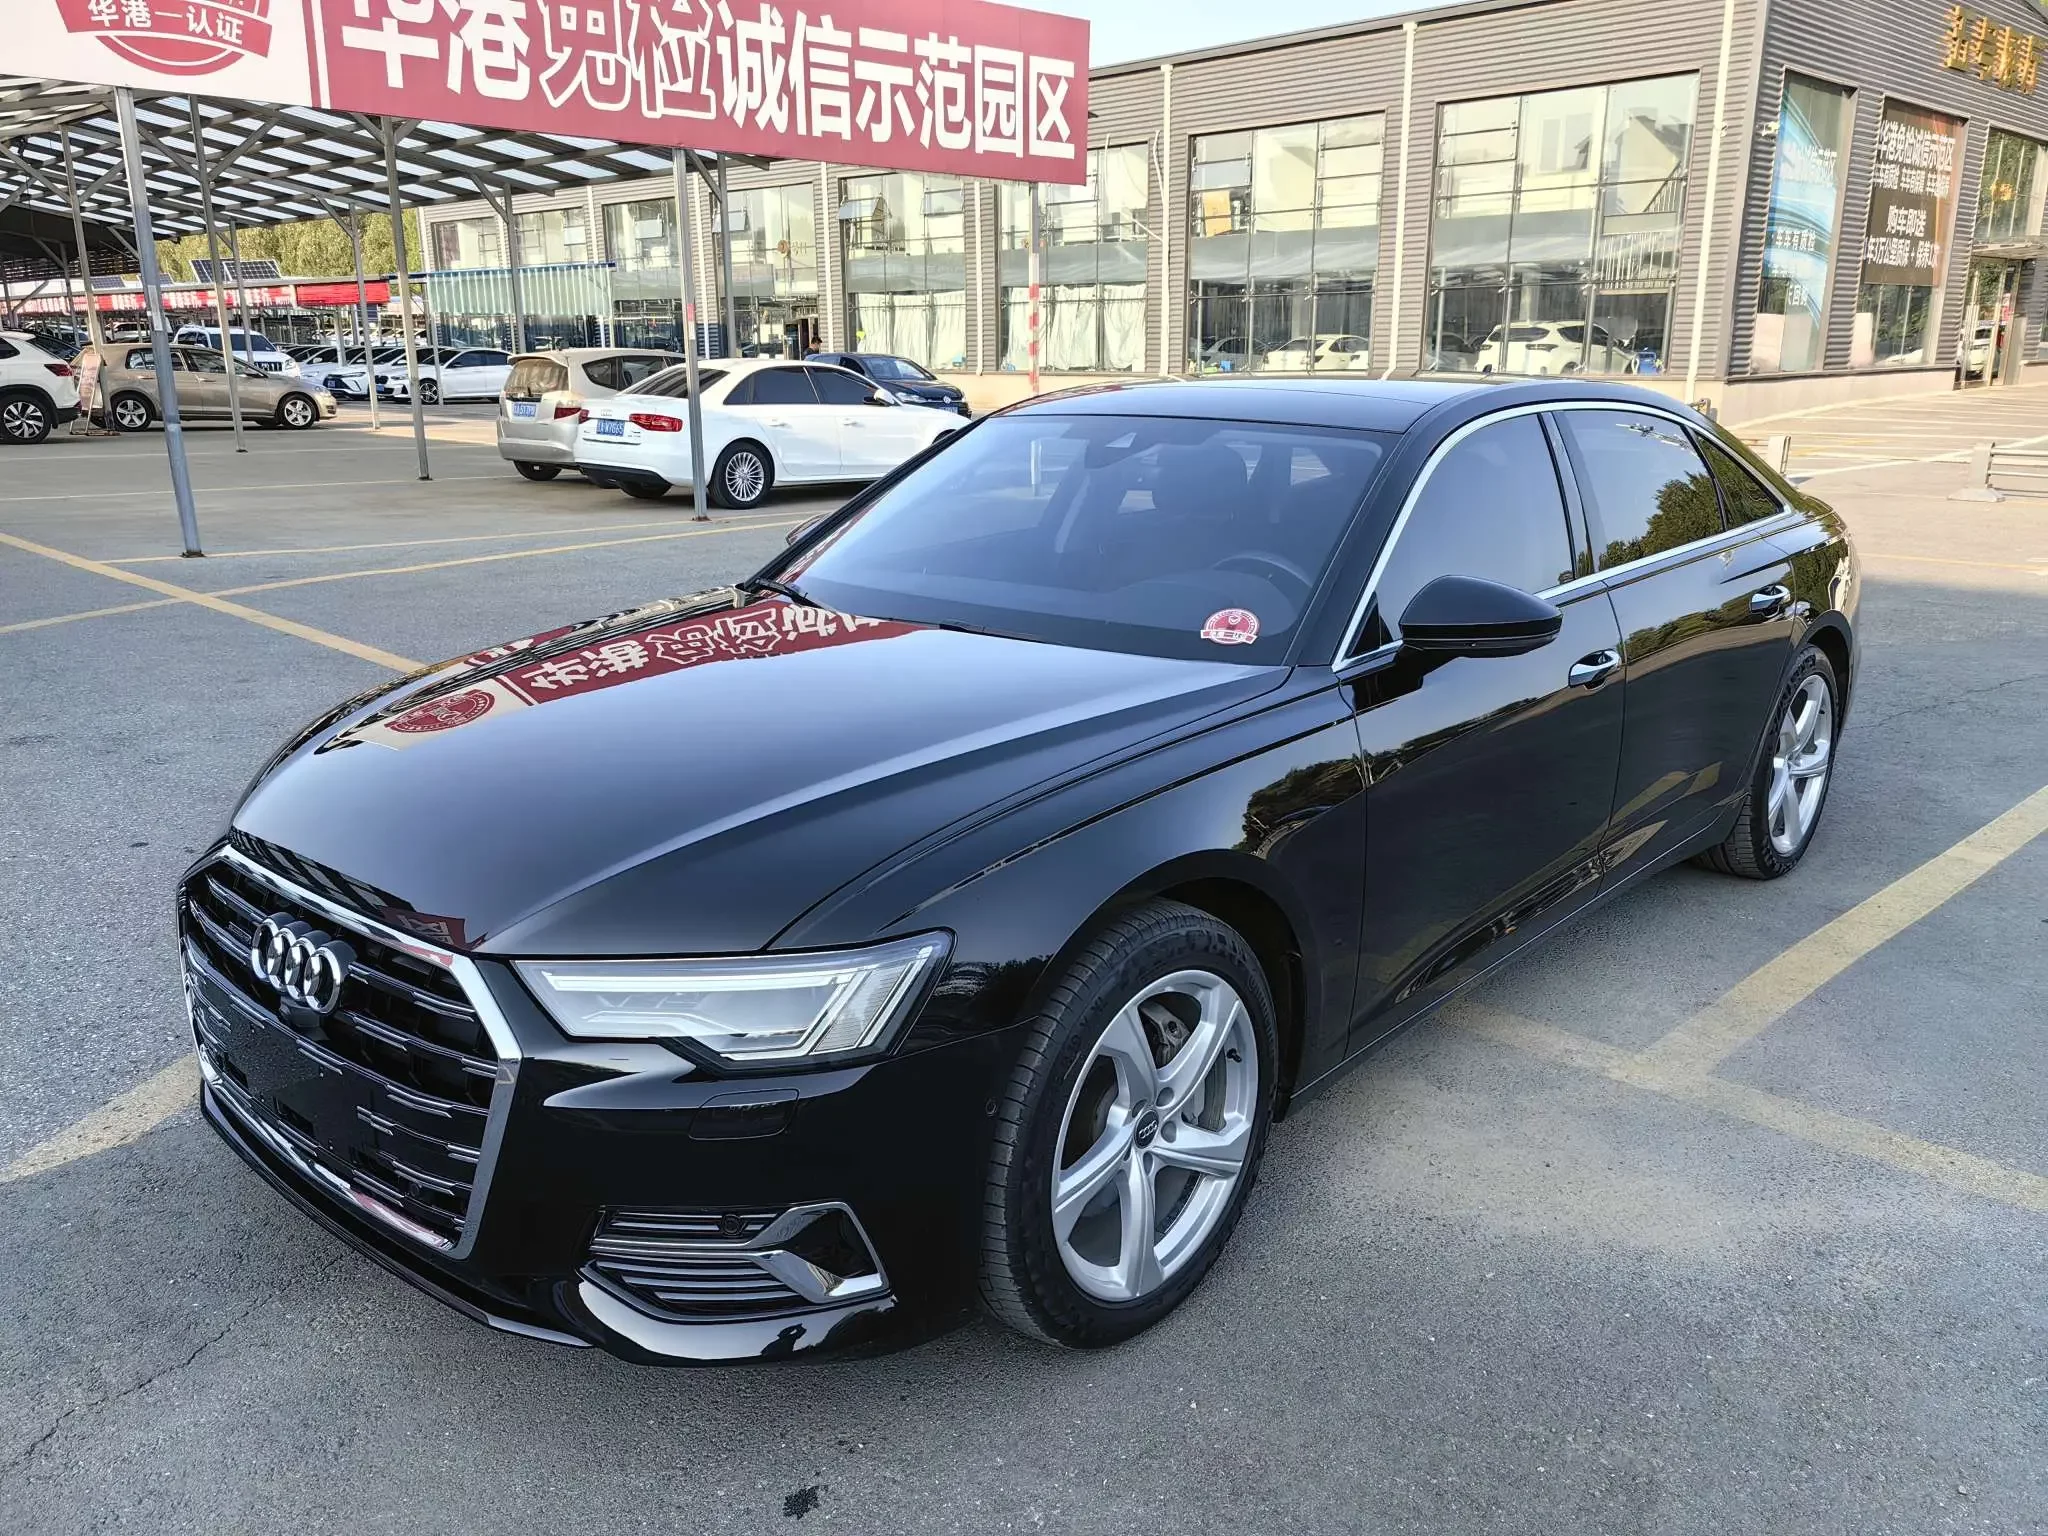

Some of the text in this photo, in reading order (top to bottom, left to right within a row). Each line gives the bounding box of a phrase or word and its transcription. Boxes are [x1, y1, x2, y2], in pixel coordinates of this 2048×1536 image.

[342, 0, 1075, 159] 华港免检诚信示范园区
